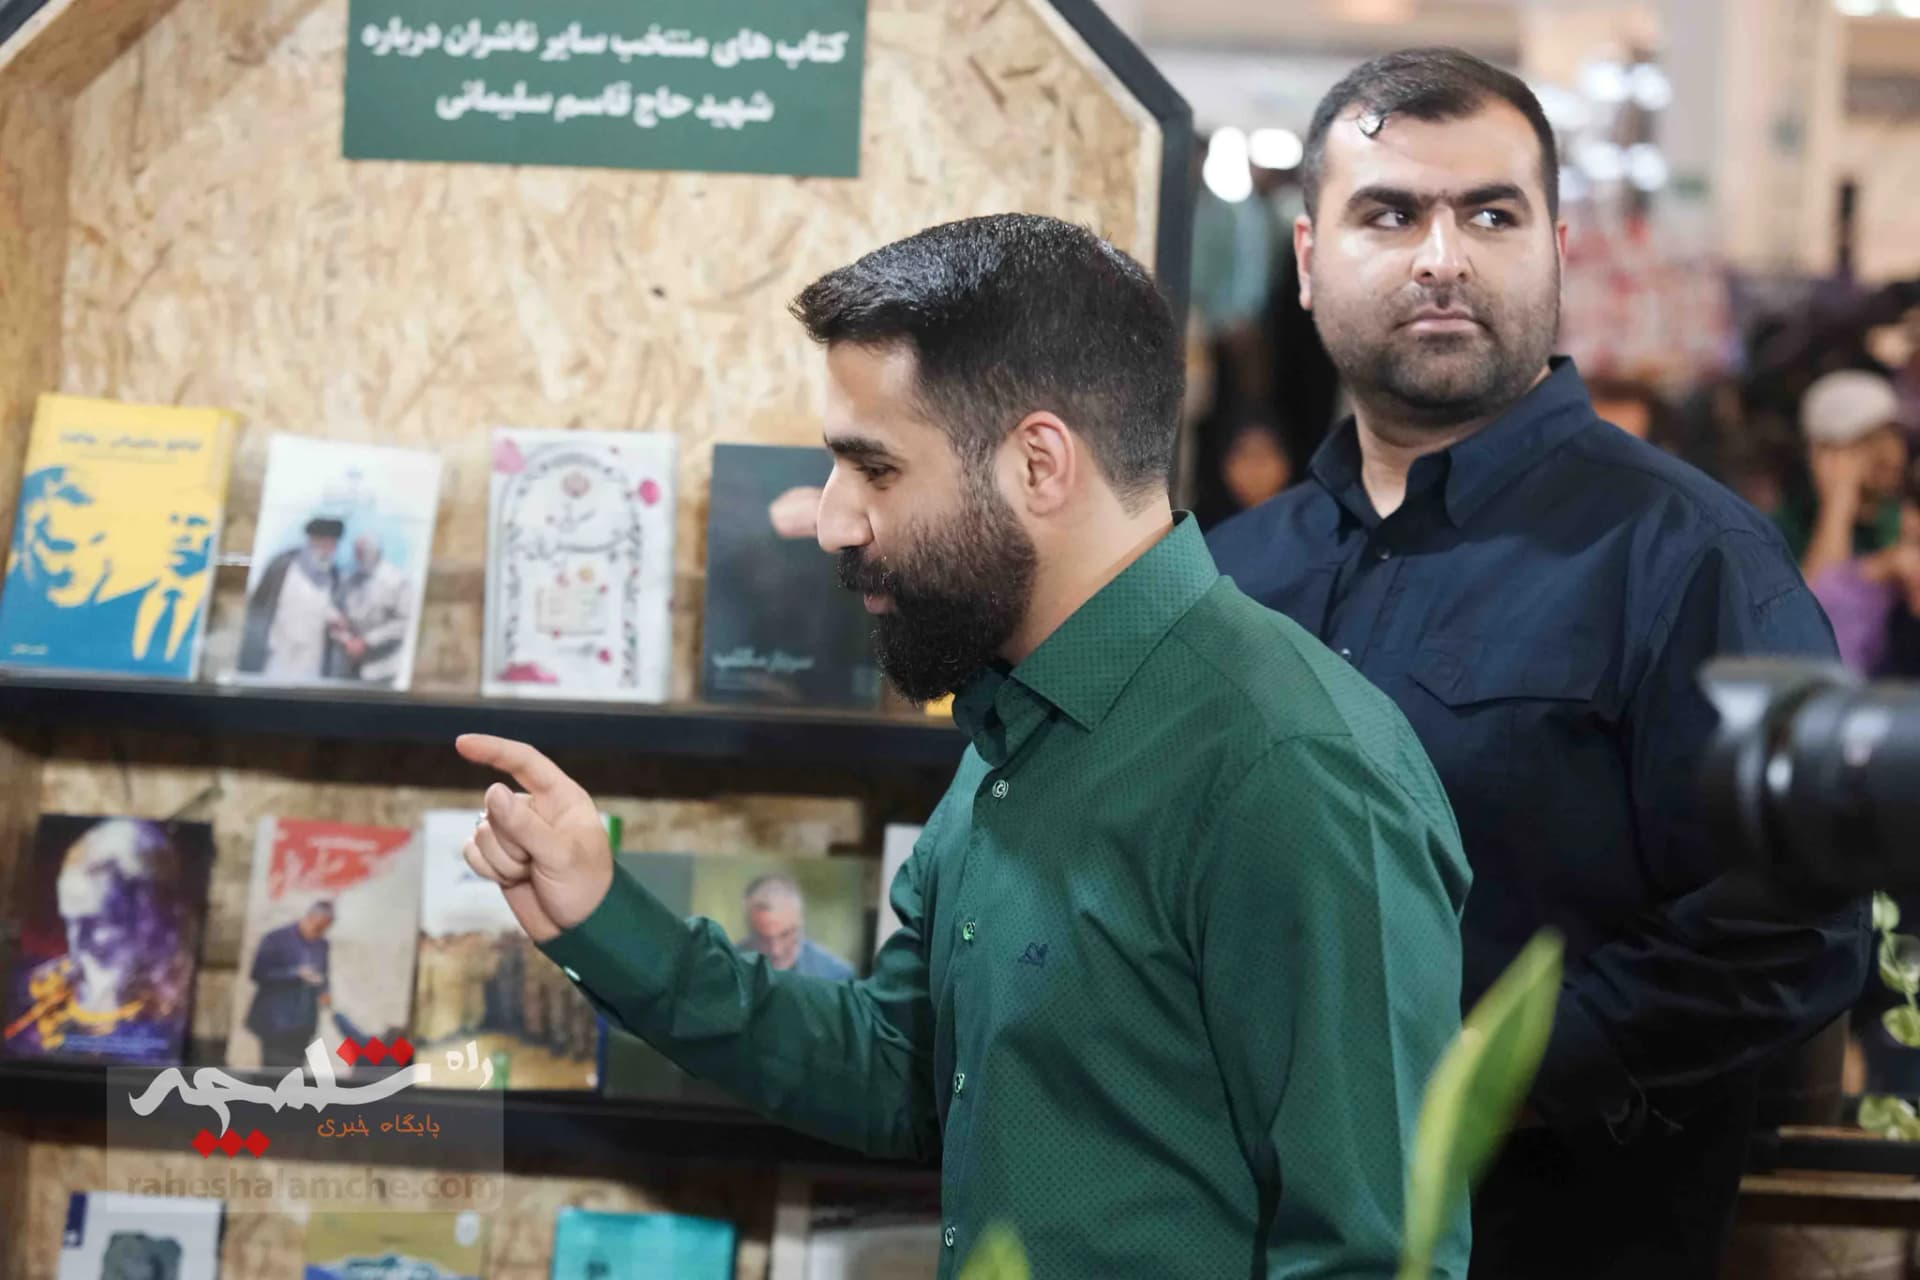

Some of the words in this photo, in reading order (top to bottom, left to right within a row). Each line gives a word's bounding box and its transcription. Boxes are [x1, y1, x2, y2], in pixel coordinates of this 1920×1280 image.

[361, 16, 442, 58] درباره
[443, 18, 540, 59] ناشران
[540, 21, 608, 62] سایر
[610, 23, 710, 64] منتخب
[711, 28, 773, 68] های
[775, 30, 850, 70] کتاب
[436, 79, 553, 121] سلیمانی
[554, 80, 632, 122] قاسم
[633, 85, 694, 129] حاج
[694, 90, 775, 130] شهید
